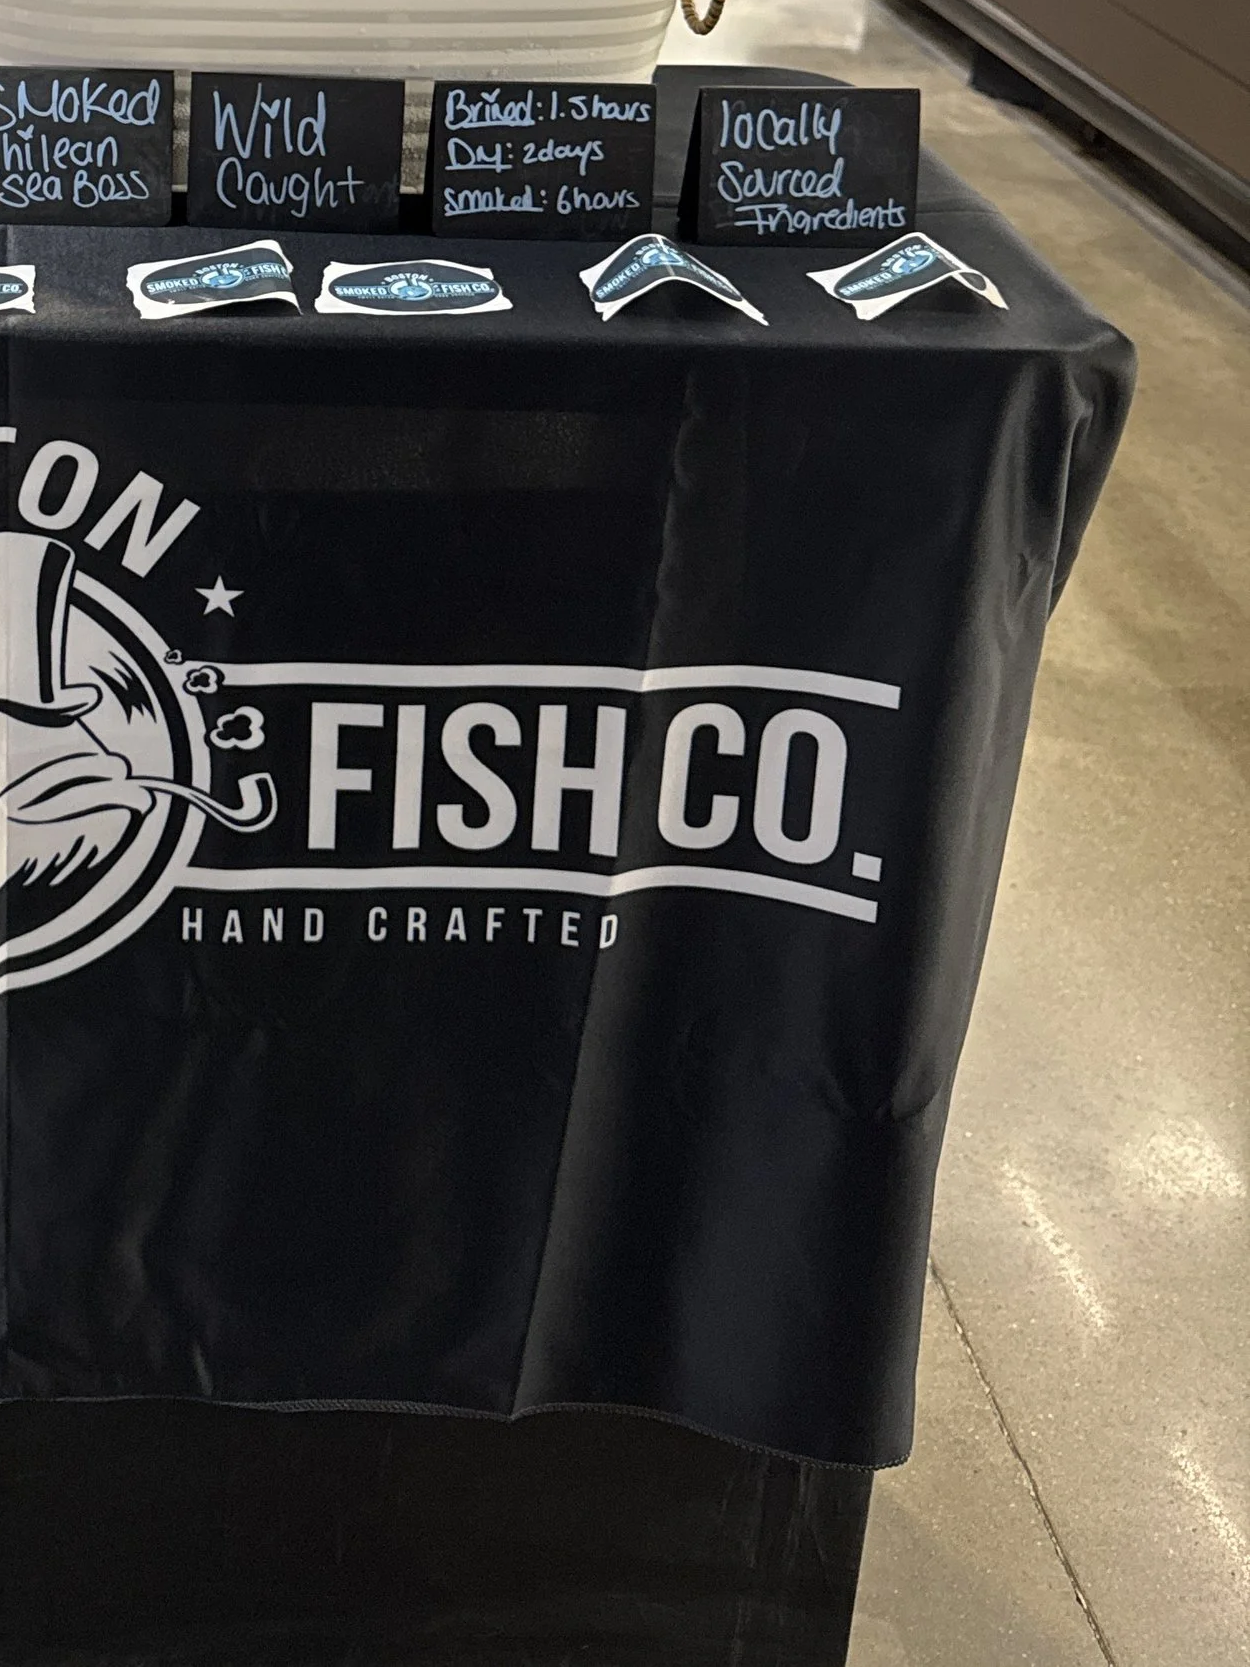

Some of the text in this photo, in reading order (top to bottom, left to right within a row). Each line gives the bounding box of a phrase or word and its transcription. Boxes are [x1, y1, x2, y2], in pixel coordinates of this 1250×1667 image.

[212, 82, 326, 160] Wild
[717, 157, 845, 204] Sourced
[734, 197, 907, 235] Ingredients
[146, 278, 199, 293] SMOKED
[253, 264, 281, 275] FISH
[335, 286, 387, 296] SMOKED
[443, 284, 472, 293] FISH
[595, 262, 641, 300] SMOKED
[306, 700, 627, 858] FISH
[656, 700, 883, 881] CO.
[182, 905, 326, 944] HAND
[367, 905, 621, 950] CRAFTED
